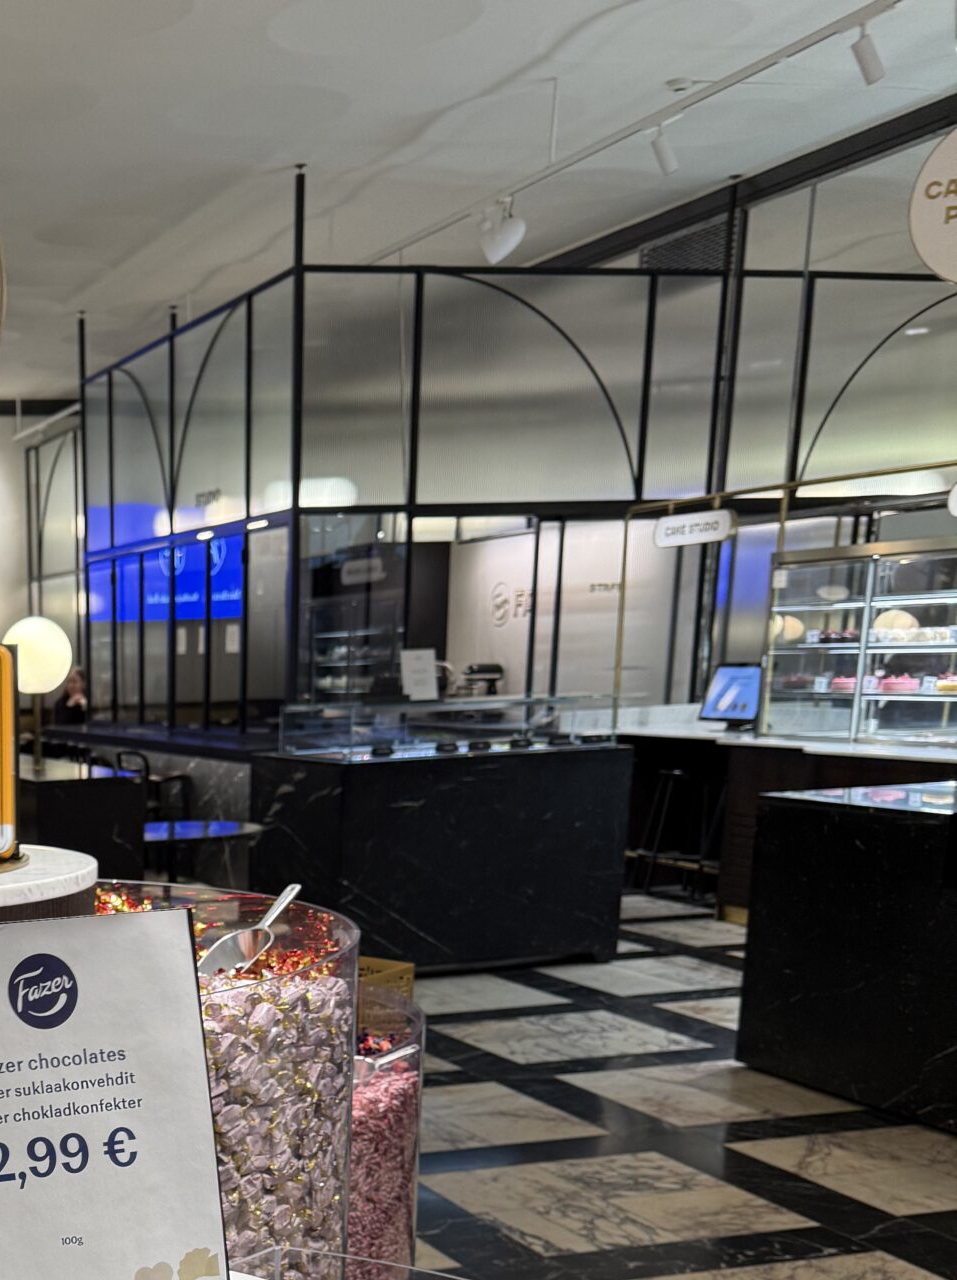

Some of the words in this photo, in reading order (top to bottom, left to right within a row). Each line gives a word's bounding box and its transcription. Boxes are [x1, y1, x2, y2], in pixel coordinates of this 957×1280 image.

[14, 966, 73, 1013] Fazer
[28, 1048, 126, 1071] chocolates
[14, 1071, 136, 1097] suklaakonvehdit
[13, 1097, 143, 1123] chokladkonfekter
[103, 1127, 137, 1167] €
[61, 1236, 84, 1246] 100g
